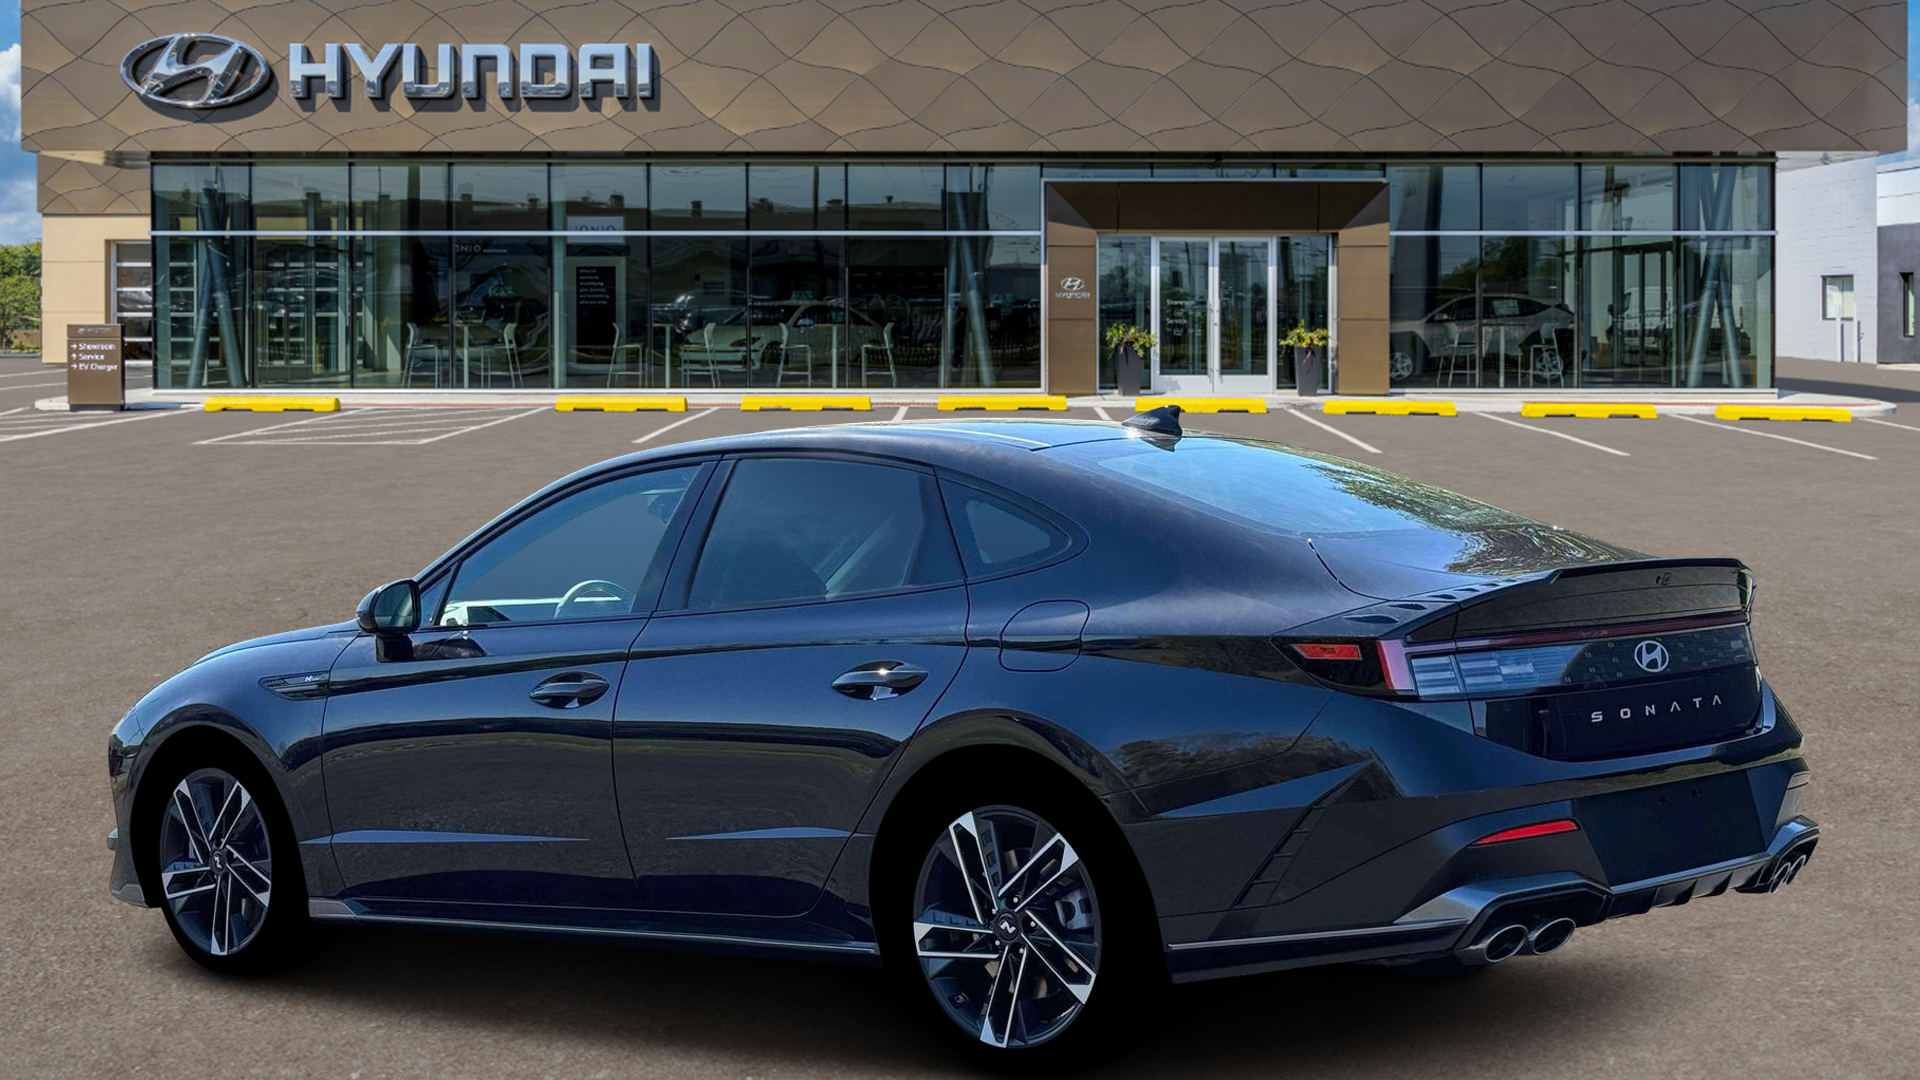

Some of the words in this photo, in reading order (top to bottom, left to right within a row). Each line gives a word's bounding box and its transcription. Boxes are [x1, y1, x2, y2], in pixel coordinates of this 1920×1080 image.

[289, 43, 653, 99] HYUNDAI
[79, 342, 116, 350] Showroom
[79, 352, 105, 360] Service
[90, 363, 118, 372] Charger
[1591, 694, 1722, 722] SONATA
